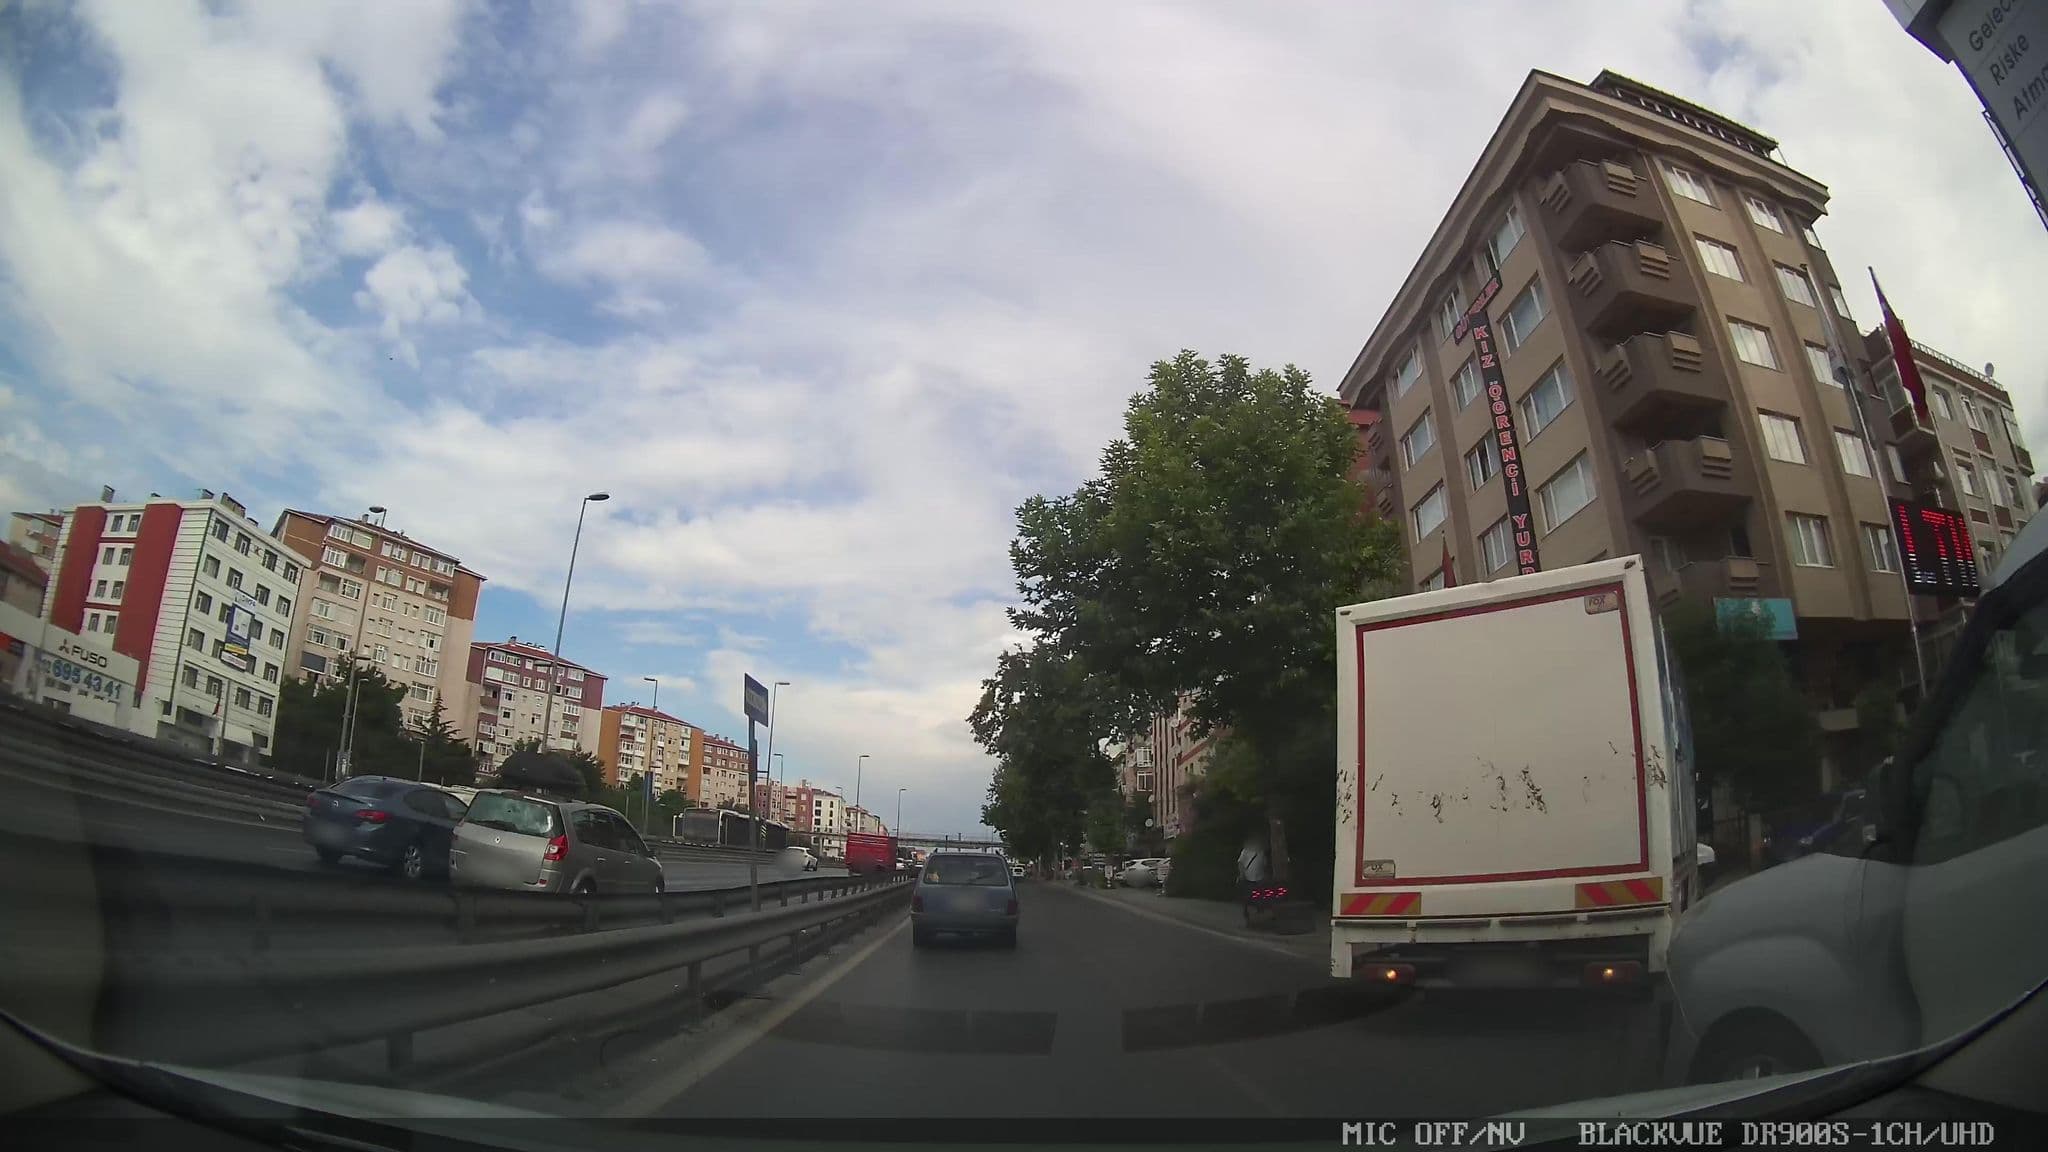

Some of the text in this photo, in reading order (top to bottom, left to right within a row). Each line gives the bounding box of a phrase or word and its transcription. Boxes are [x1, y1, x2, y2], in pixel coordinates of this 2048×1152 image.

[1968, 0, 2015, 51] Gelec
[1990, 35, 2029, 85] Riske
[1474, 326, 1495, 369] KIZ
[71, 645, 108, 668] FUSO
